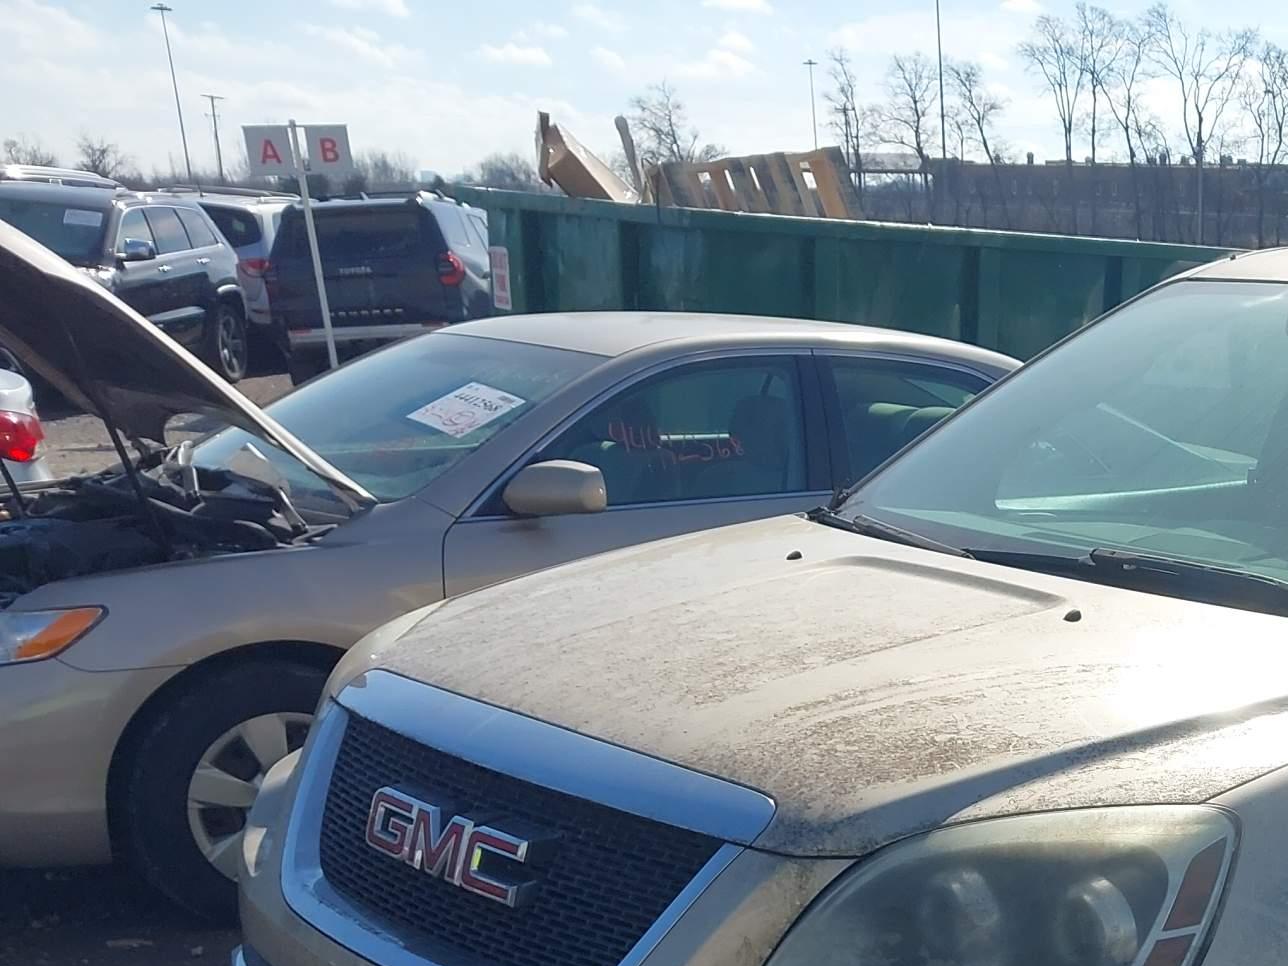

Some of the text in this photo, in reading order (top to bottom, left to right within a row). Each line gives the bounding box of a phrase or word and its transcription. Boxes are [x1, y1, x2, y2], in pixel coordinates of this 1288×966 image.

[262, 139, 282, 164] A
[320, 138, 339, 162] B
[366, 786, 529, 908] GMC
